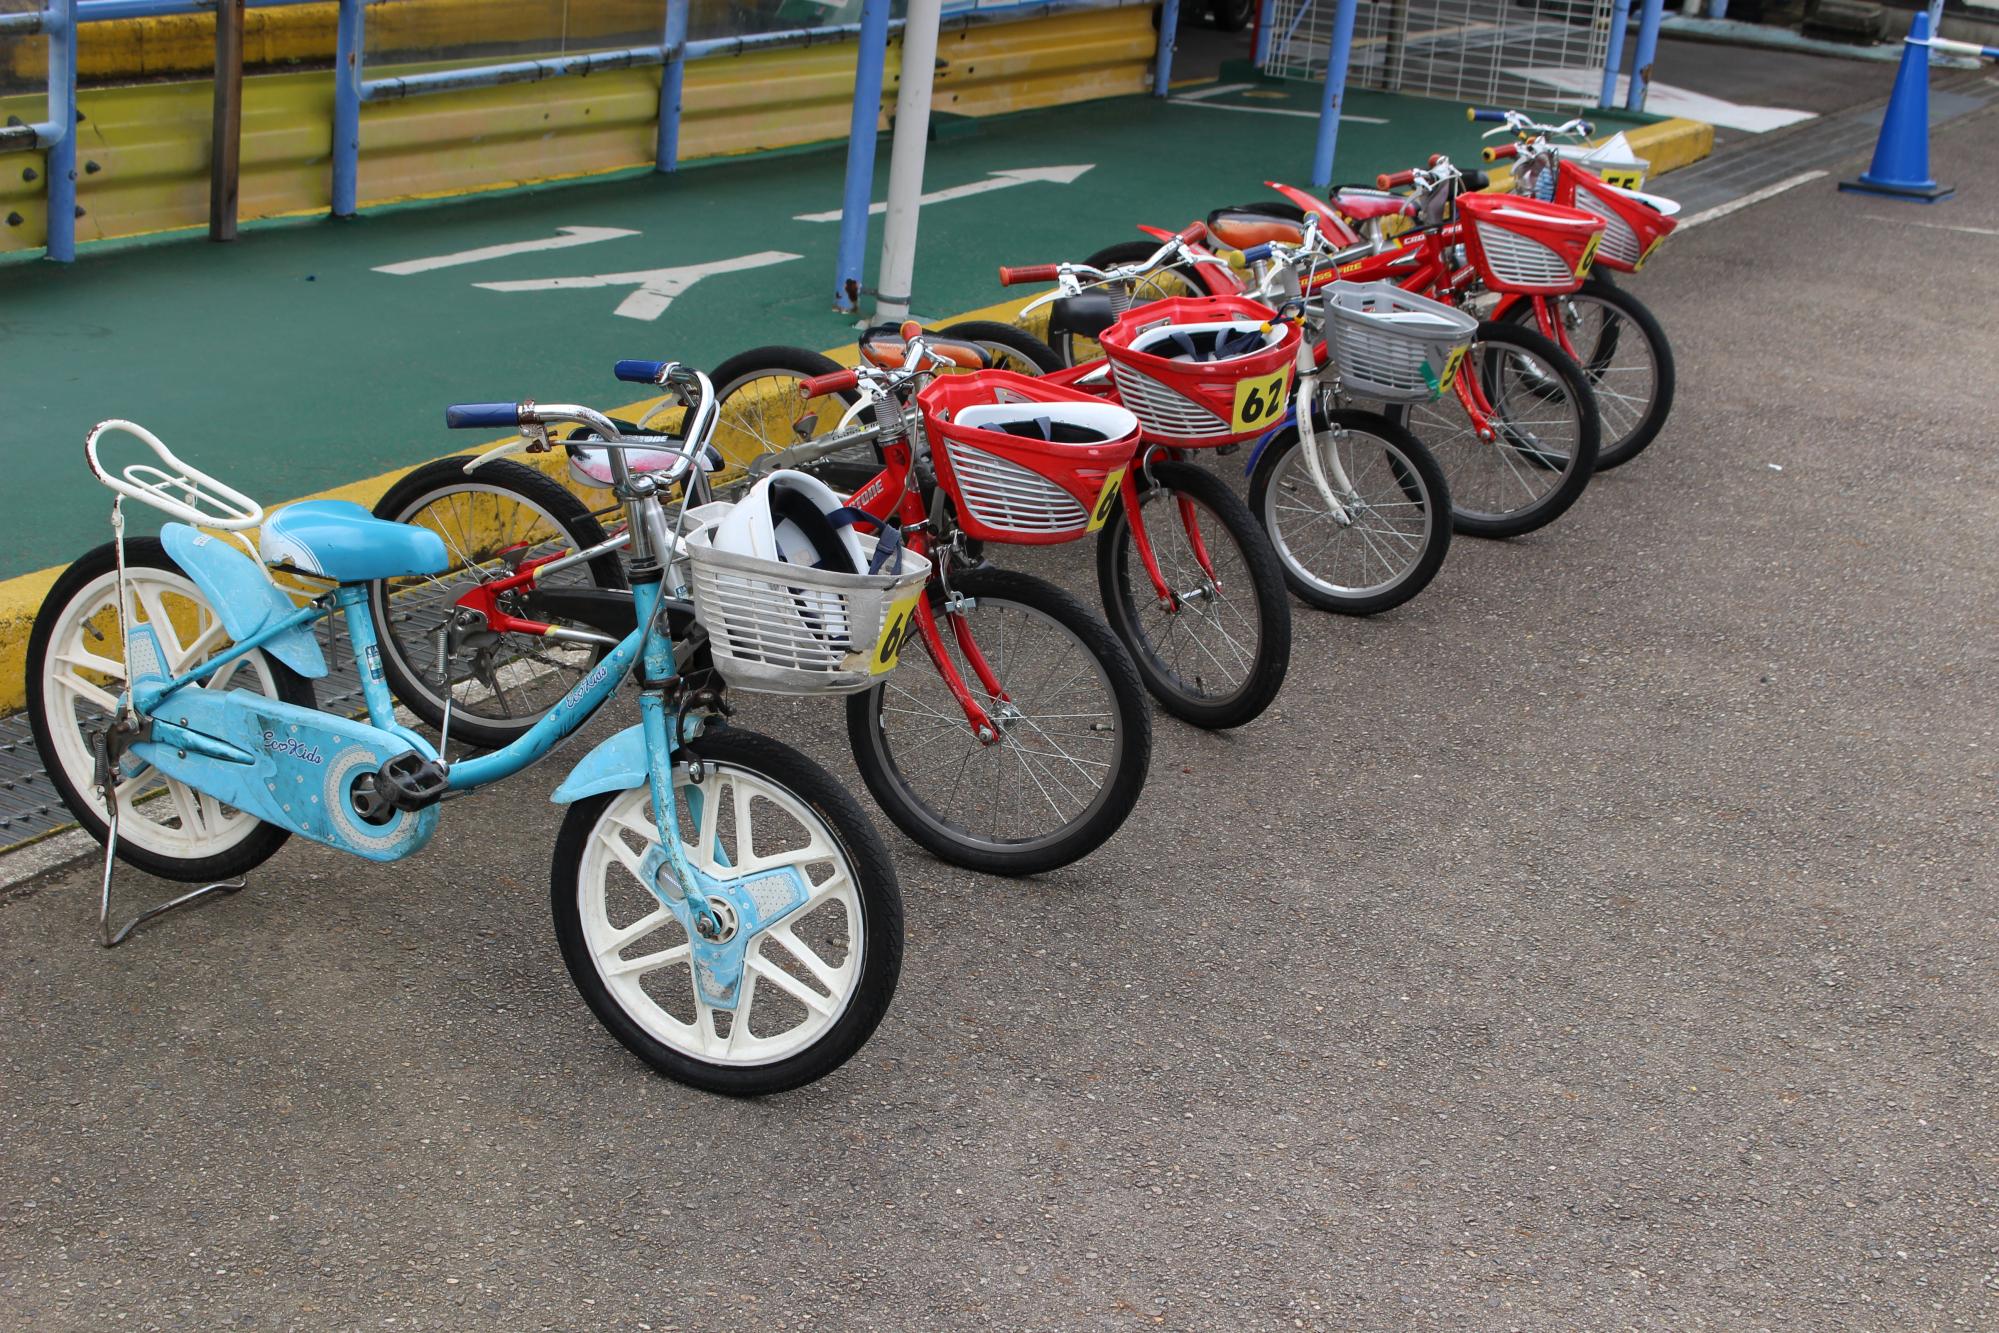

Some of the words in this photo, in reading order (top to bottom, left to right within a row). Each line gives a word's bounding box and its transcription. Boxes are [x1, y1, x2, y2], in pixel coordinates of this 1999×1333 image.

[1300, 270, 1332, 286] ROSS
[1241, 377, 1283, 424] 62
[263, 730, 323, 765] EcoKids
